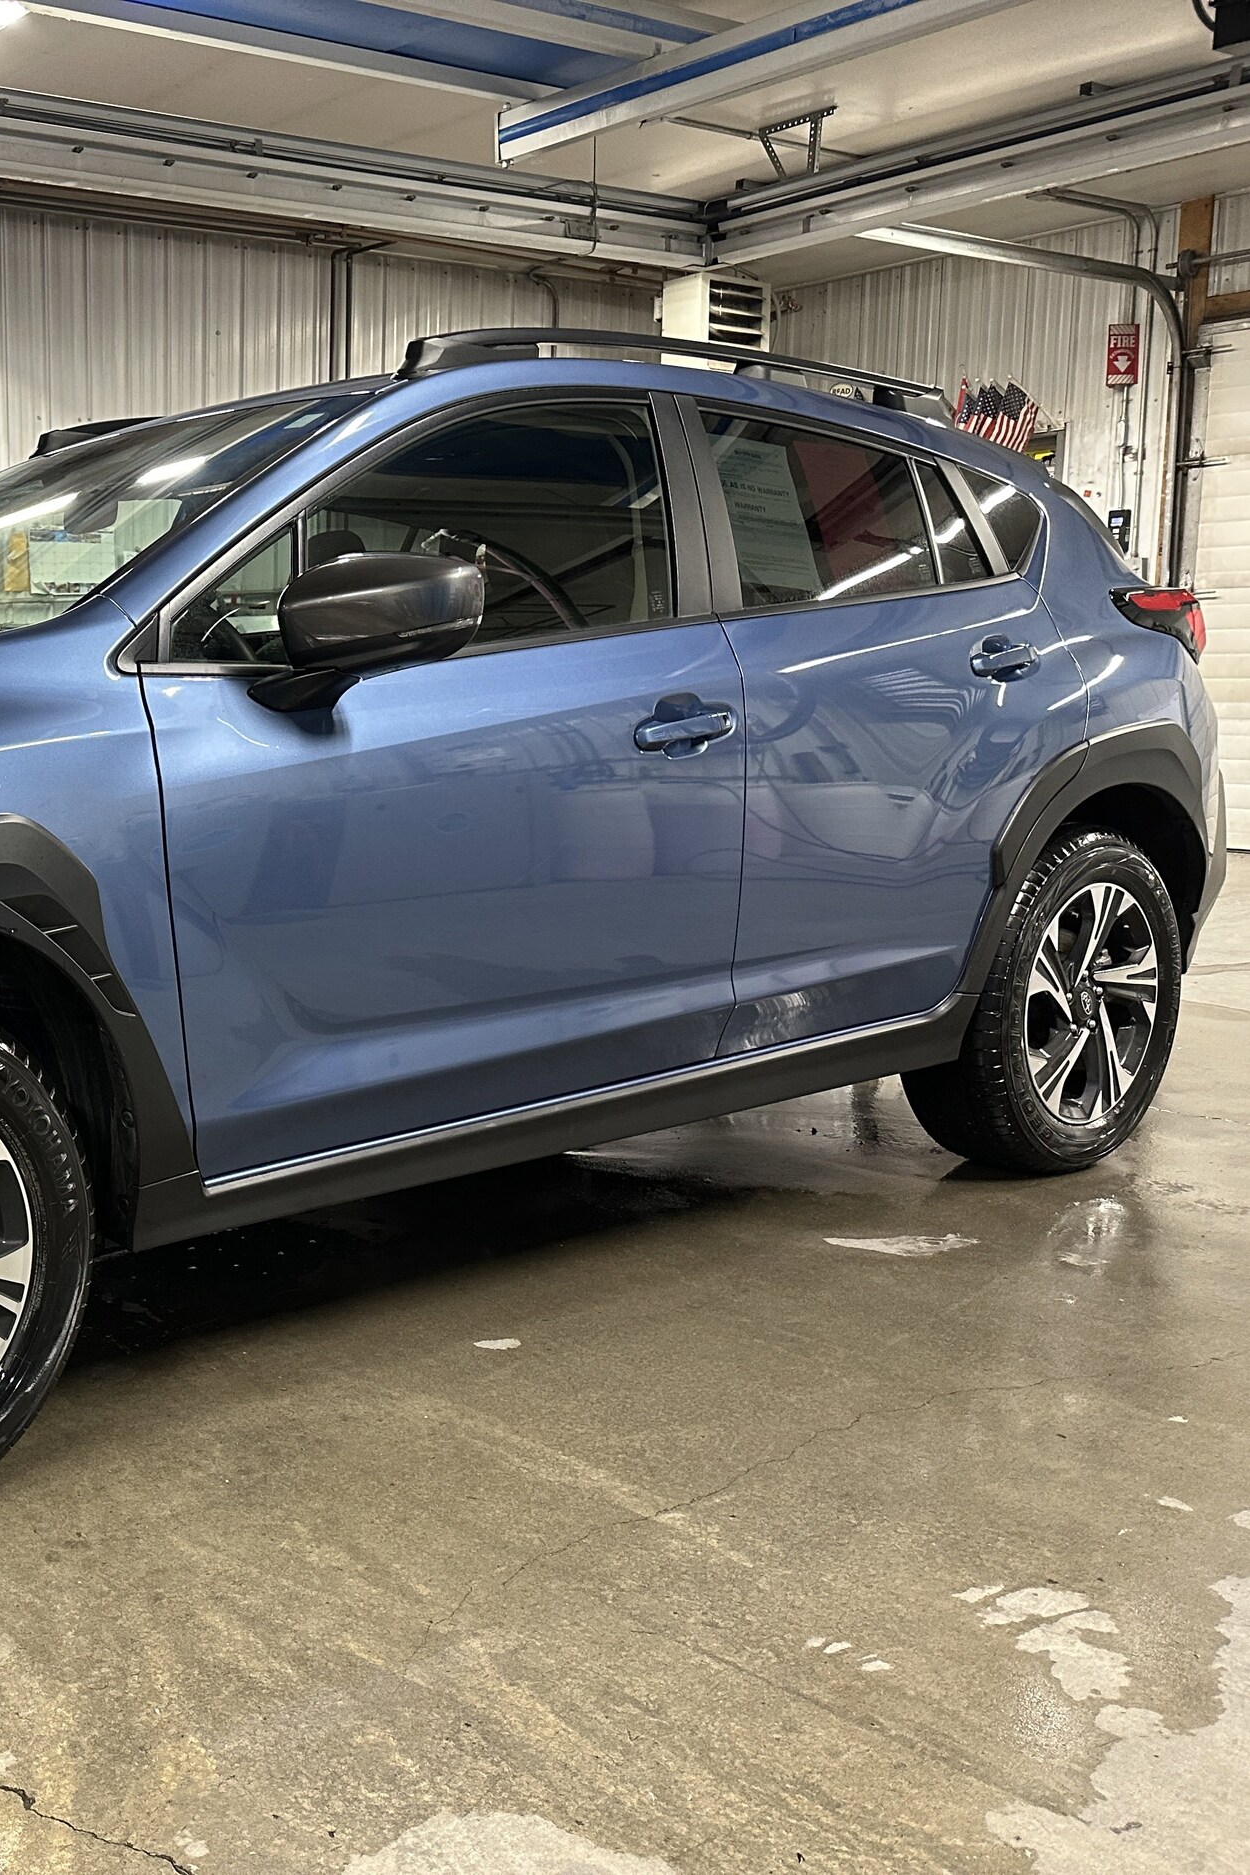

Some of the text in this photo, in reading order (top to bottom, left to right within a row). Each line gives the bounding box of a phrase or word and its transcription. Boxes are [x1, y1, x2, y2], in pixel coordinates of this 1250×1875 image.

[1110, 335, 1136, 348] FIRE
[734, 501, 767, 513] WARRANTY
[1, 1068, 79, 1218] YOKOHAMA
